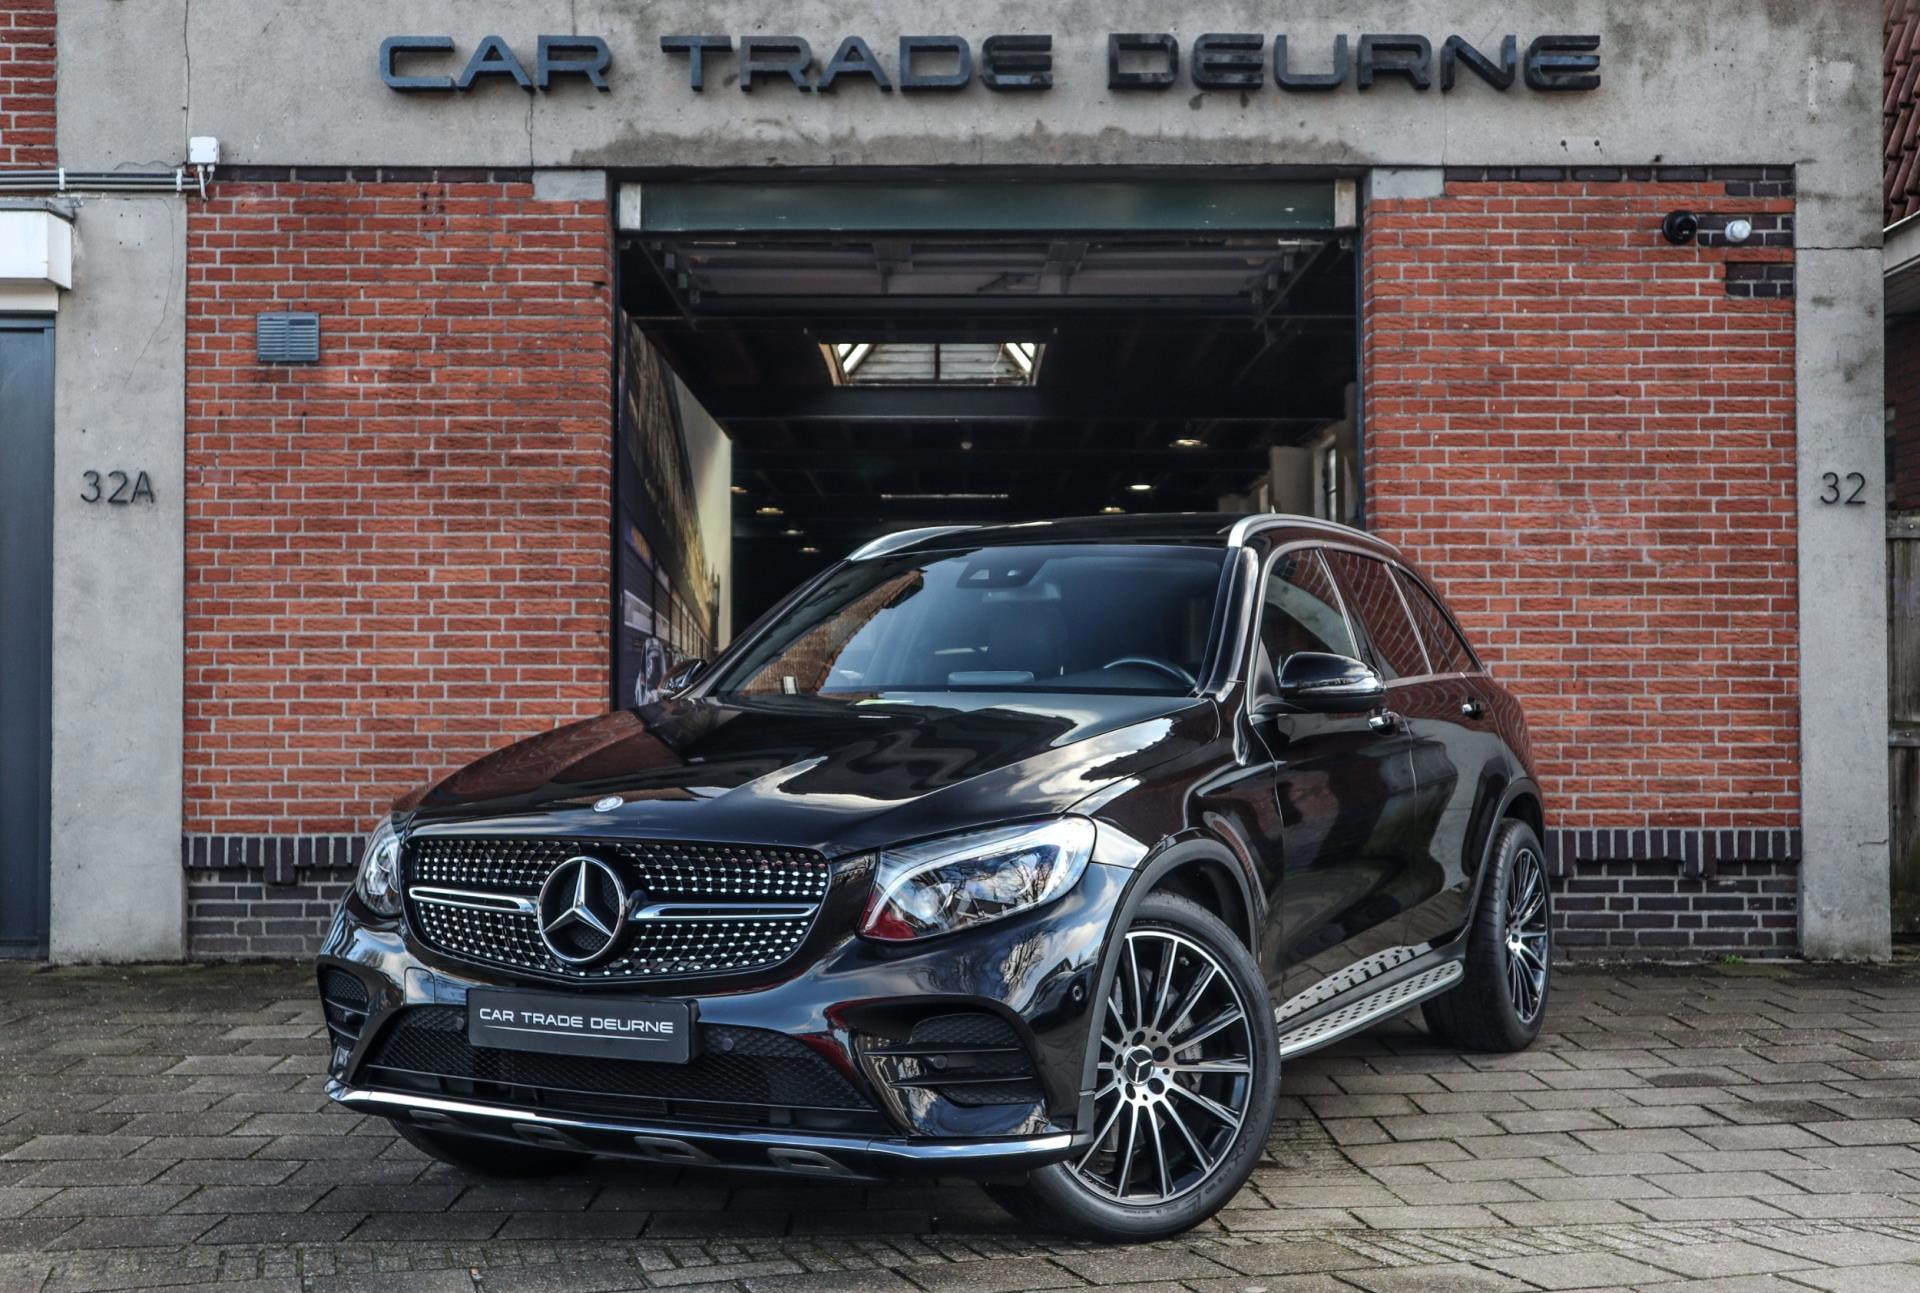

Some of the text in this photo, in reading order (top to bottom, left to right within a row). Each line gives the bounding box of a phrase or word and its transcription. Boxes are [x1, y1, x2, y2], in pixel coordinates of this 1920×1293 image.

[379, 33, 1600, 93] CAR TRADE DEURNE
[80, 470, 155, 504] 32A
[1820, 471, 1866, 505] 32
[479, 1008, 675, 1034] CAR TRADE DEURNE
